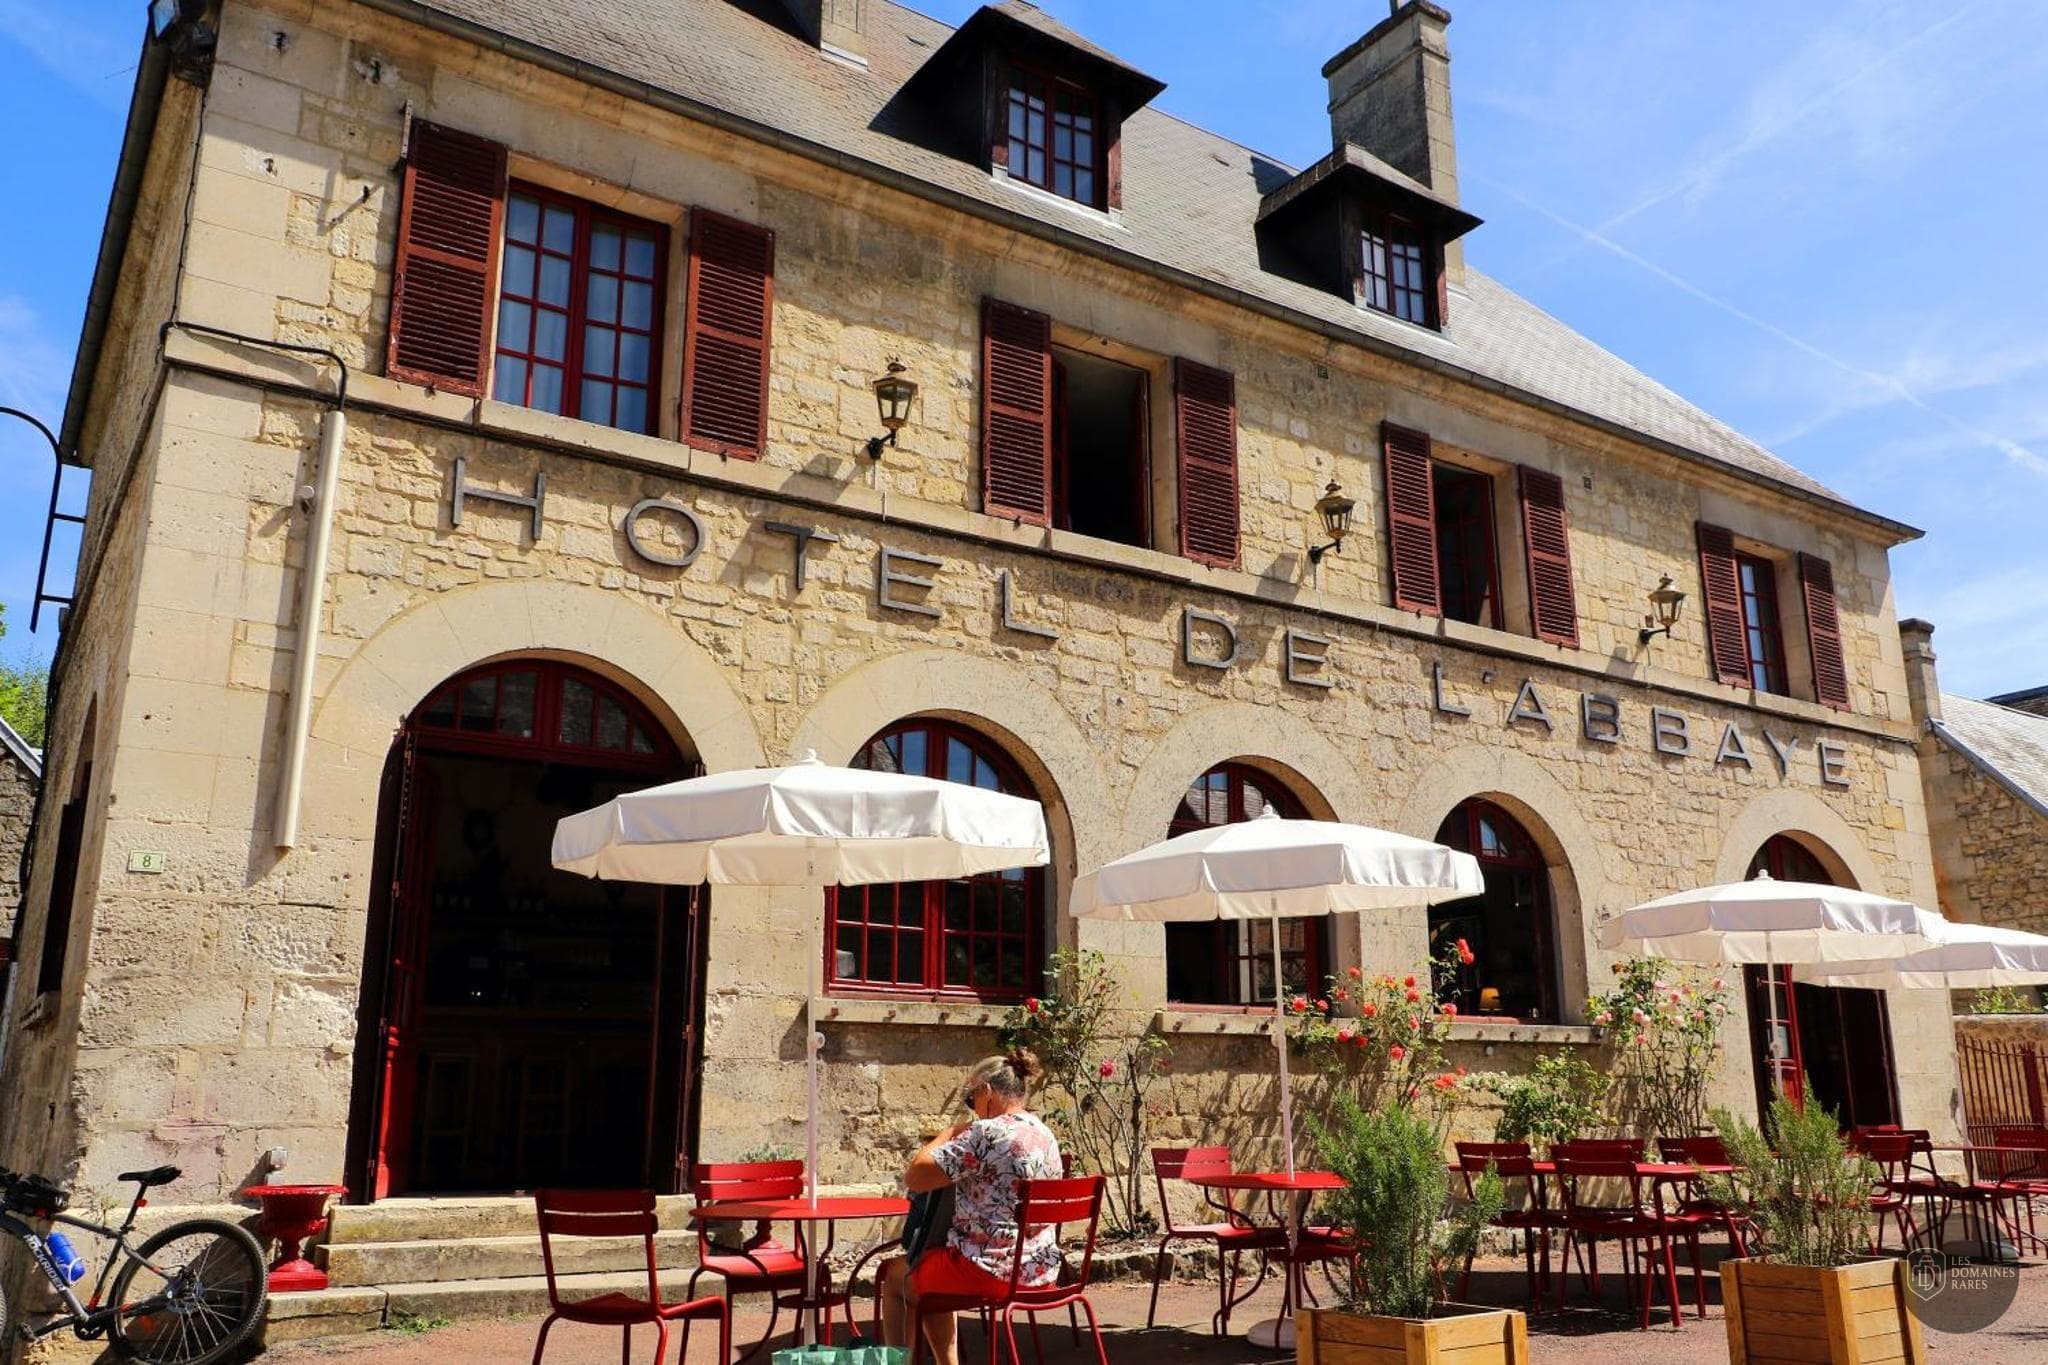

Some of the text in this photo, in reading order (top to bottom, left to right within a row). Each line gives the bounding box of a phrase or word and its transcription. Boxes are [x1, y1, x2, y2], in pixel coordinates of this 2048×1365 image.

[453, 457, 1850, 787] HOTEL DE L'ABBAYE
[142, 855, 151, 868] 8
